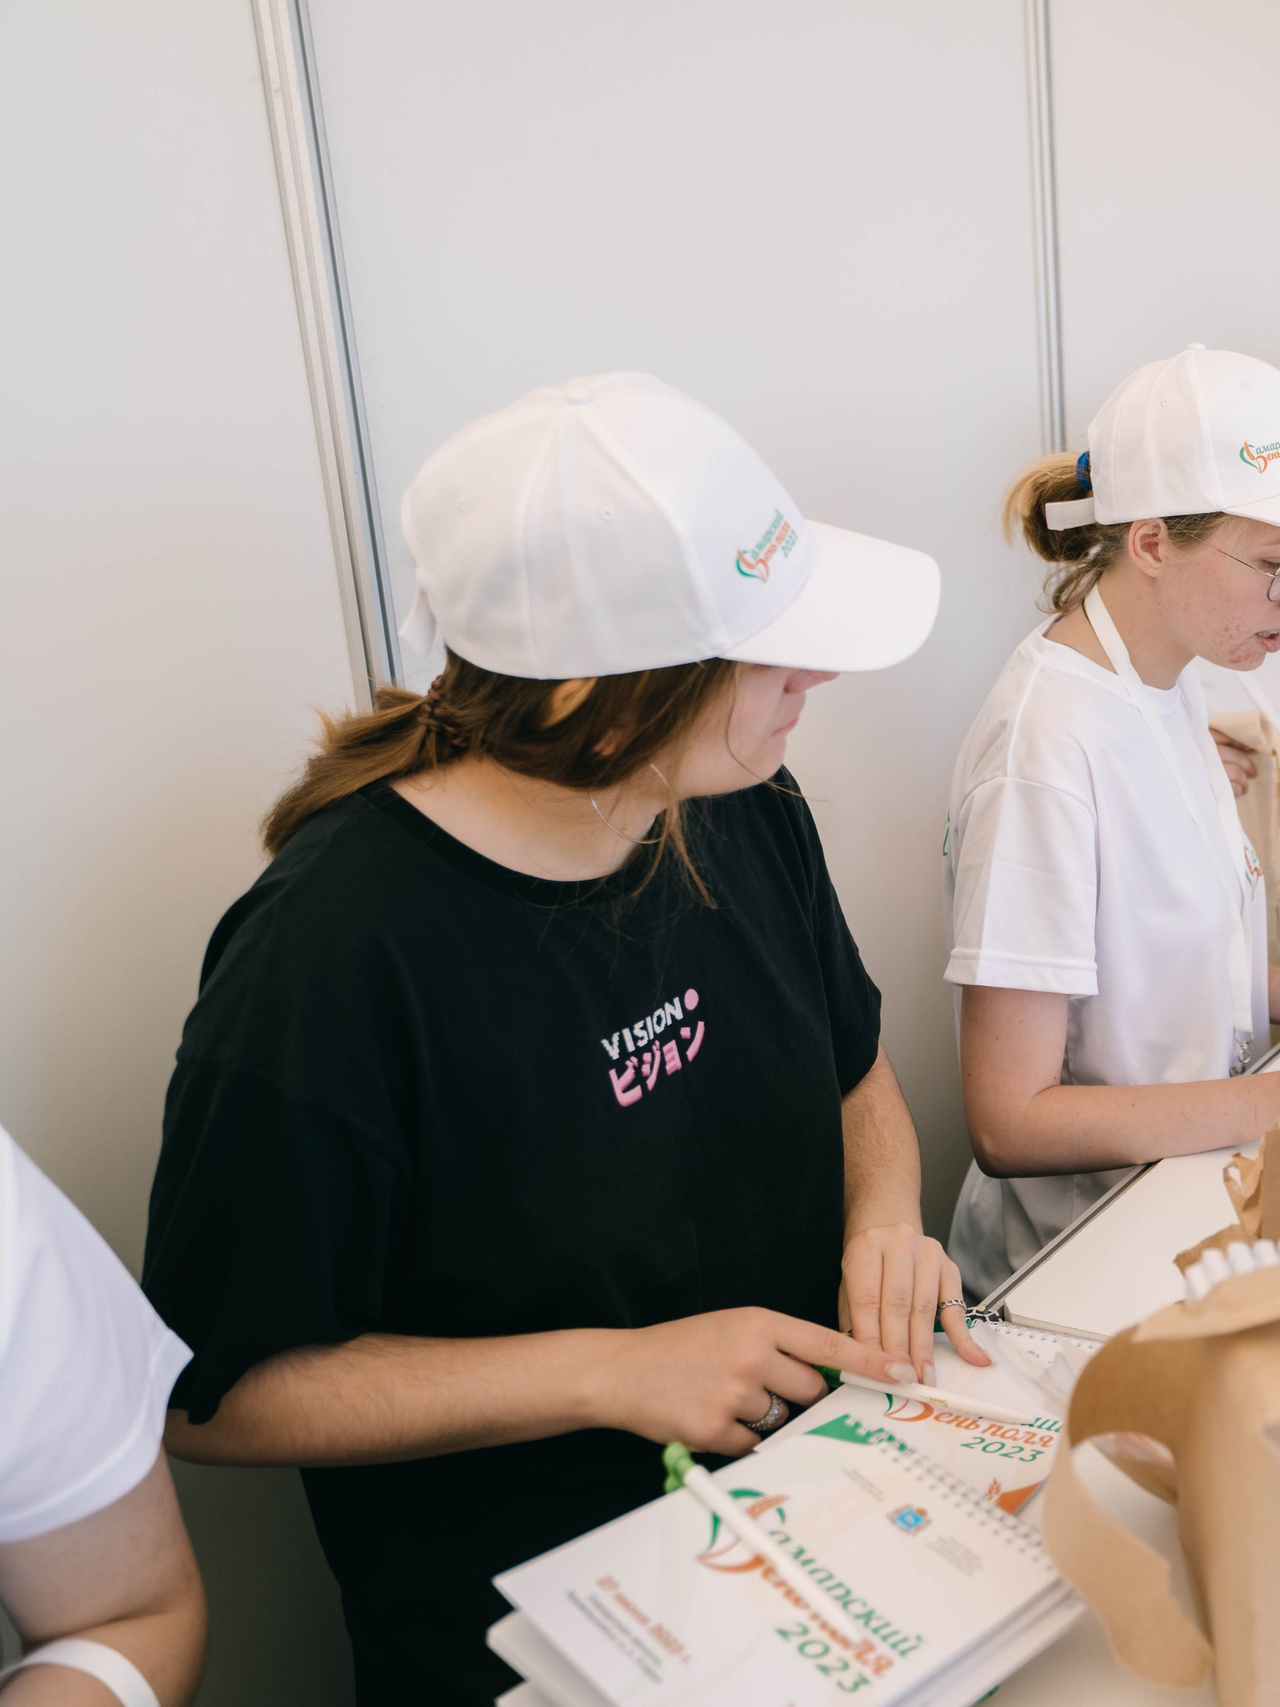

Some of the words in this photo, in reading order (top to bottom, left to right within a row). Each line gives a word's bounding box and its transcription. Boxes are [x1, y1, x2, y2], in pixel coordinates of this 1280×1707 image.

[601, 997, 684, 1060] VISION
[608, 1021, 705, 1107] ビジョン
[960, 1436, 1045, 1463] 2023
[981, 1421, 1054, 1449] поля
[775, 1621, 872, 1693] 2023
